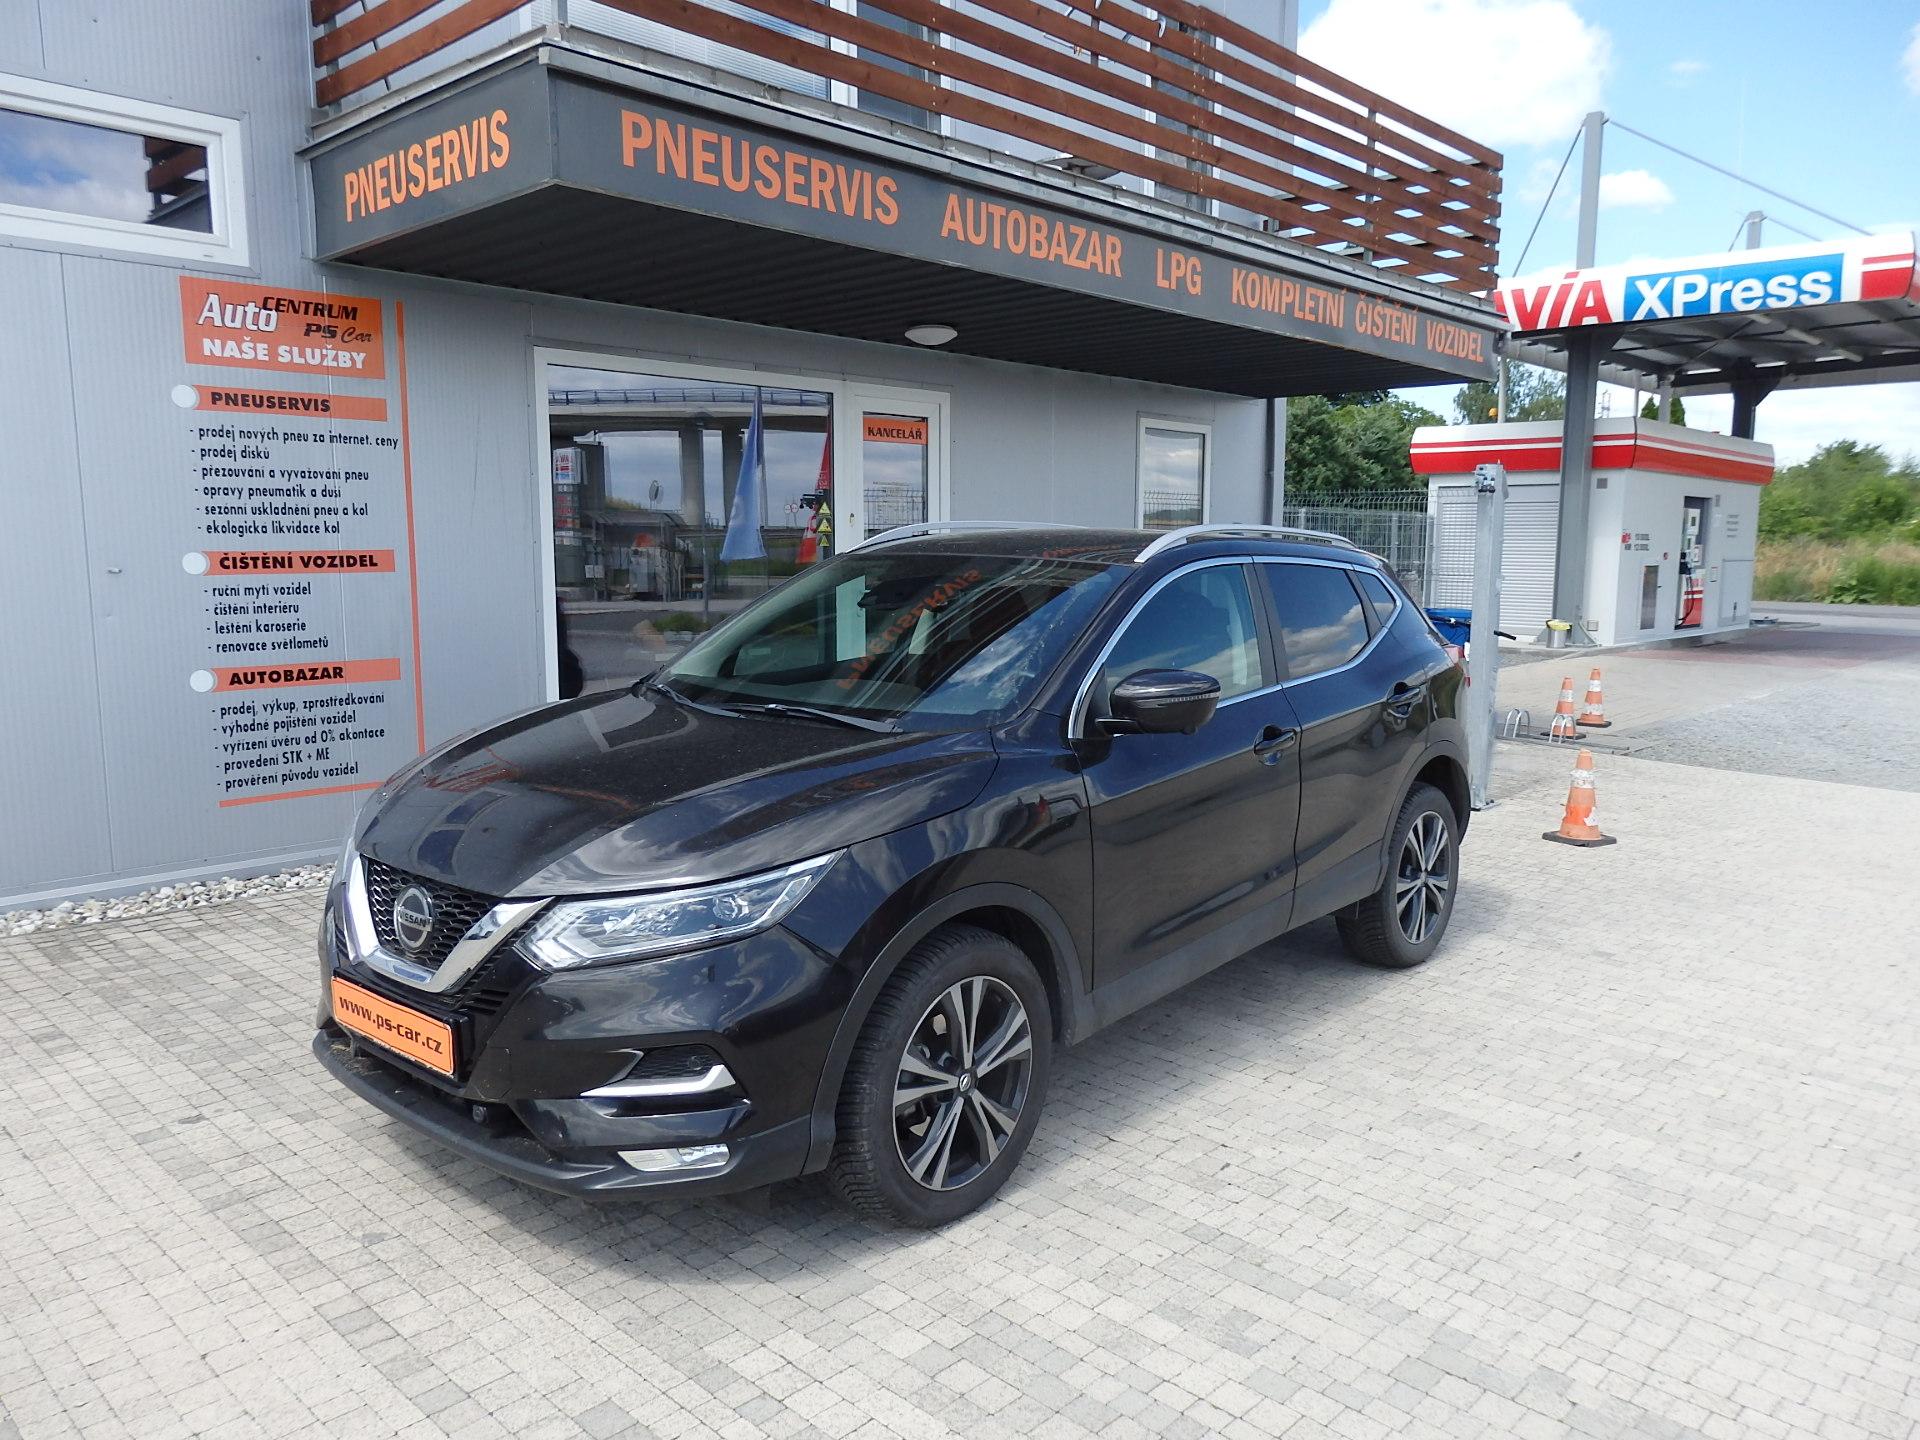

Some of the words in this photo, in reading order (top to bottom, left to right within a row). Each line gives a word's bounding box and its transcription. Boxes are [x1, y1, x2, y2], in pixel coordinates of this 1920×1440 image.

[344, 109, 511, 222] PNEUSERVIS
[619, 109, 899, 226] PNEUSERVIS
[940, 193, 1123, 278] AUTOBAZAR
[1155, 248, 1202, 296] LPG
[1231, 267, 1345, 328] KOMPLETNÍ
[1354, 291, 1418, 346] ČIŠTĚNÍ
[1425, 320, 1485, 363] VOZIDEL
[1633, 270, 1833, 321] XPress
[196, 292, 279, 333] Auto
[262, 295, 359, 321] CENTRUM
[303, 322, 339, 339] PS
[340, 326, 374, 344] Car
[202, 336, 270, 362] NAŠE
[277, 344, 367, 370] SLUŽBY
[210, 391, 331, 413] PNEUSERVIS
[198, 424, 236, 442] prodej
[239, 427, 279, 443] nových
[283, 431, 309, 444] pneu
[312, 433, 325, 443] za
[329, 430, 373, 445] internet.
[375, 437, 399, 450] ceny
[867, 426, 923, 440] KANCELÁŘ
[200, 443, 237, 462] prodej
[201, 464, 265, 480] přezouvání
[268, 469, 276, 478] a
[344, 471, 369, 483] pneu
[203, 486, 244, 500] opravy
[248, 484, 306, 500] pneumatik
[310, 488, 317, 498] a
[250, 501, 310, 516] uskladnění
[313, 506, 339, 518] pneu
[342, 507, 349, 516] a
[352, 502, 369, 516] kol
[271, 520, 320, 534] likvidace
[323, 520, 340, 534] kol
[219, 552, 293, 570] ČIŠTĚNÍ
[299, 554, 379, 569] VOZIDEL
[212, 584, 241, 597] ruční
[273, 581, 312, 596] vozidel
[213, 602, 250, 616] čištění
[253, 601, 300, 615] interiéru
[215, 620, 252, 635] leštění
[255, 618, 307, 633] karoserie
[216, 642, 268, 654] renovace
[271, 635, 330, 651] světlometů
[229, 666, 344, 686] AUTOBAZAR
[220, 700, 258, 720] prodej,
[302, 692, 386, 713] zprostředkování
[221, 718, 270, 738] výhodné
[273, 715, 318, 734] pojištění
[320, 709, 357, 726] vozidel
[304, 730, 318, 745] od
[320, 728, 336, 744] 0%
[339, 728, 386, 742] akontace
[224, 753, 280, 775] provedení
[282, 749, 304, 765] STK
[316, 747, 331, 761] ME
[225, 772, 279, 793] prověření
[281, 766, 320, 786] původu
[322, 761, 360, 778] vozidel
[338, 996, 445, 1055] www.ps-car.cz
